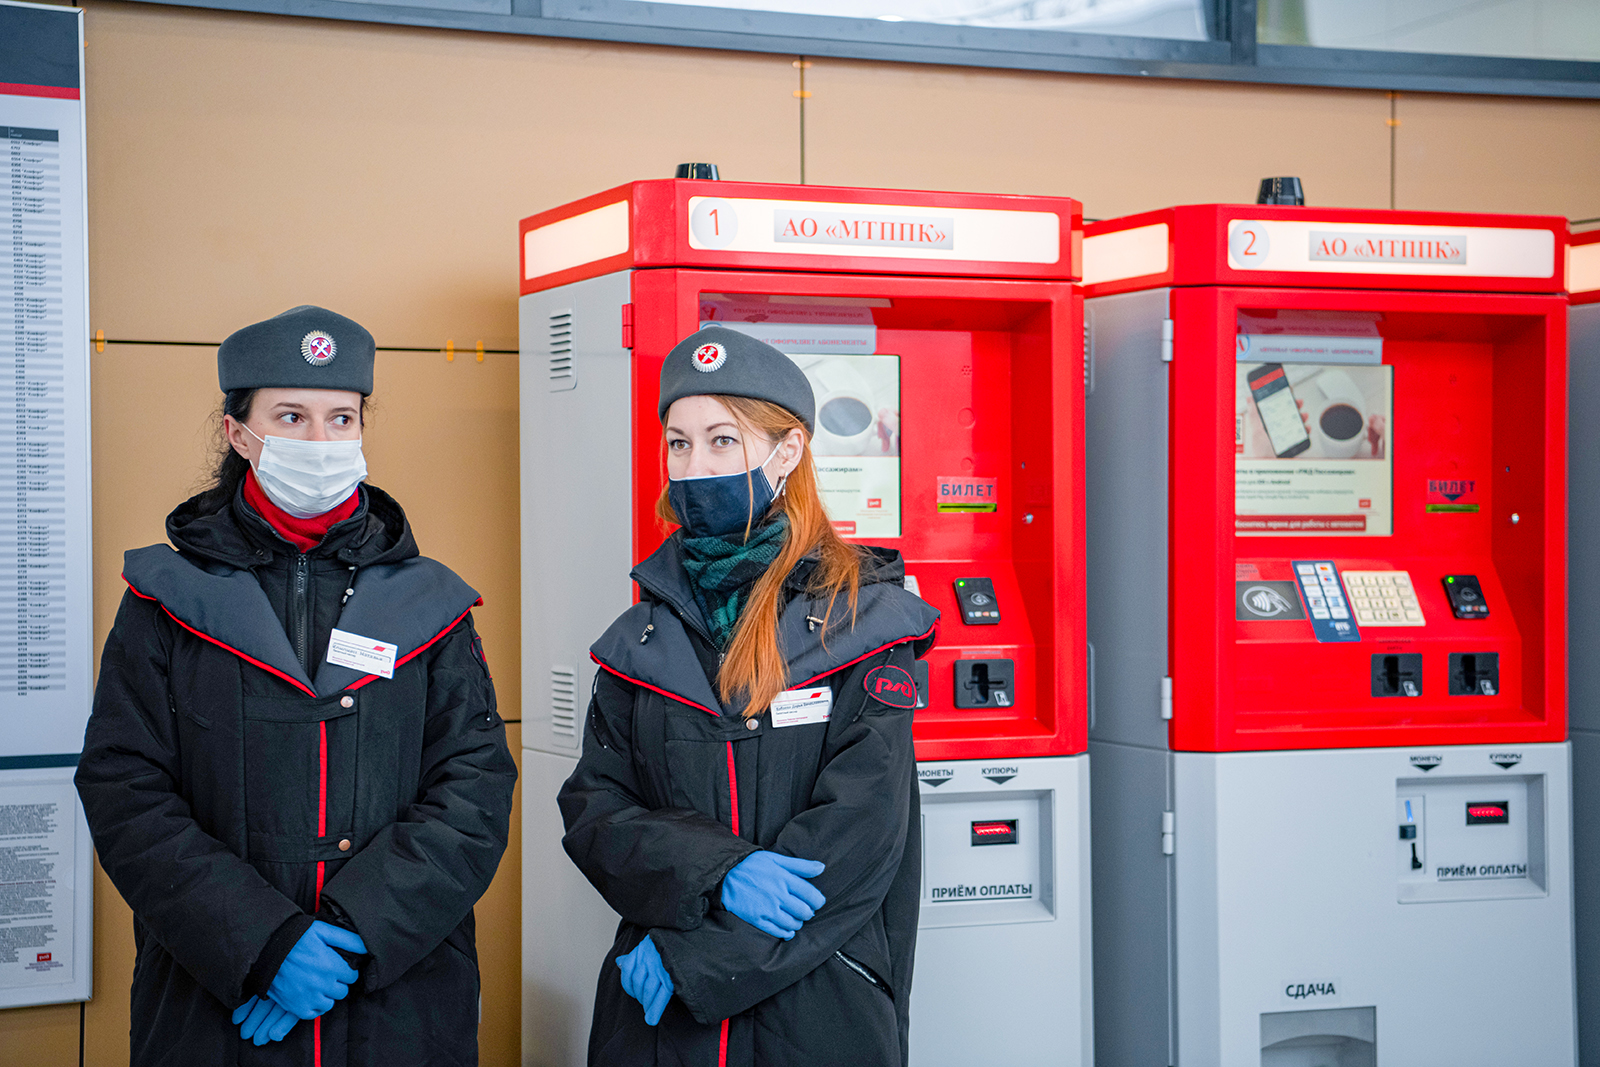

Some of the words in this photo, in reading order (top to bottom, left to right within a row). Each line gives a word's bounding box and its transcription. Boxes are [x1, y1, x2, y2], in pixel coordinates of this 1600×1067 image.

[709, 208, 719, 236] 1
[782, 217, 818, 238] АО
[825, 219, 946, 242] «МТППК»
[1243, 230, 1257, 256] 2
[1316, 239, 1348, 257] АО
[1354, 239, 1461, 260] «МТППК»
[941, 484, 993, 496] БИЛЕТ
[1429, 480, 1475, 492] БИЛЕТ
[918, 769, 954, 777] МОНЕТЫ
[981, 767, 1018, 775] КУПЮРЫ
[1437, 864, 1476, 877] ПРИЁМ
[1480, 864, 1527, 875] ОПЛАТЫ
[932, 885, 976, 898] ПРИЁМ
[980, 884, 1032, 895] ОПЛАТЫ
[1285, 982, 1336, 999] СДАЧА
